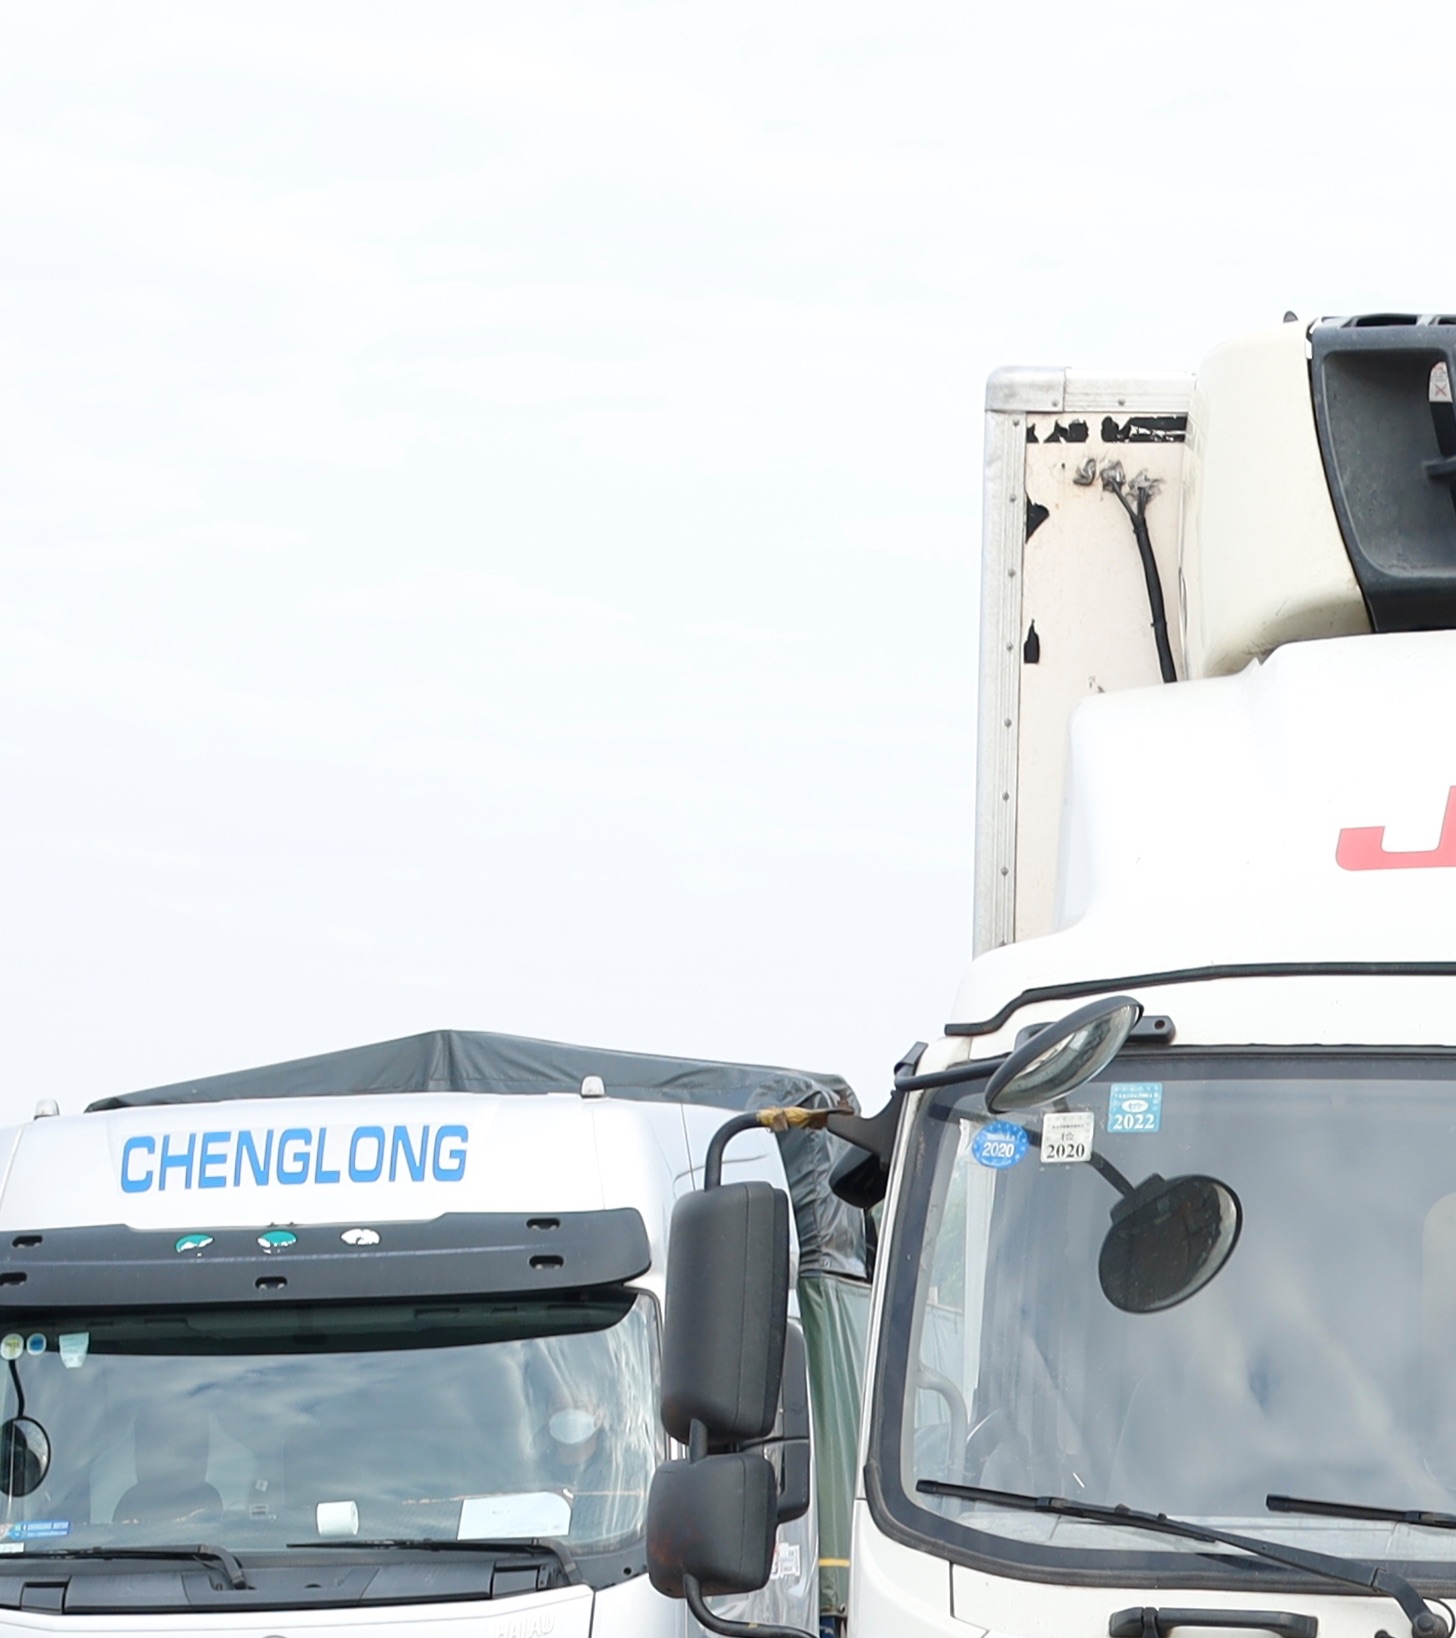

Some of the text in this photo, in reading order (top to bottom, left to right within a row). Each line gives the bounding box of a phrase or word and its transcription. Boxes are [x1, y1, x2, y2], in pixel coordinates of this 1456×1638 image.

[1113, 1114, 1155, 1129] 2022
[982, 1141, 1015, 1157] 2020
[1047, 1143, 1085, 1158] 2020
[121, 1125, 468, 1193] CHENGLONG
